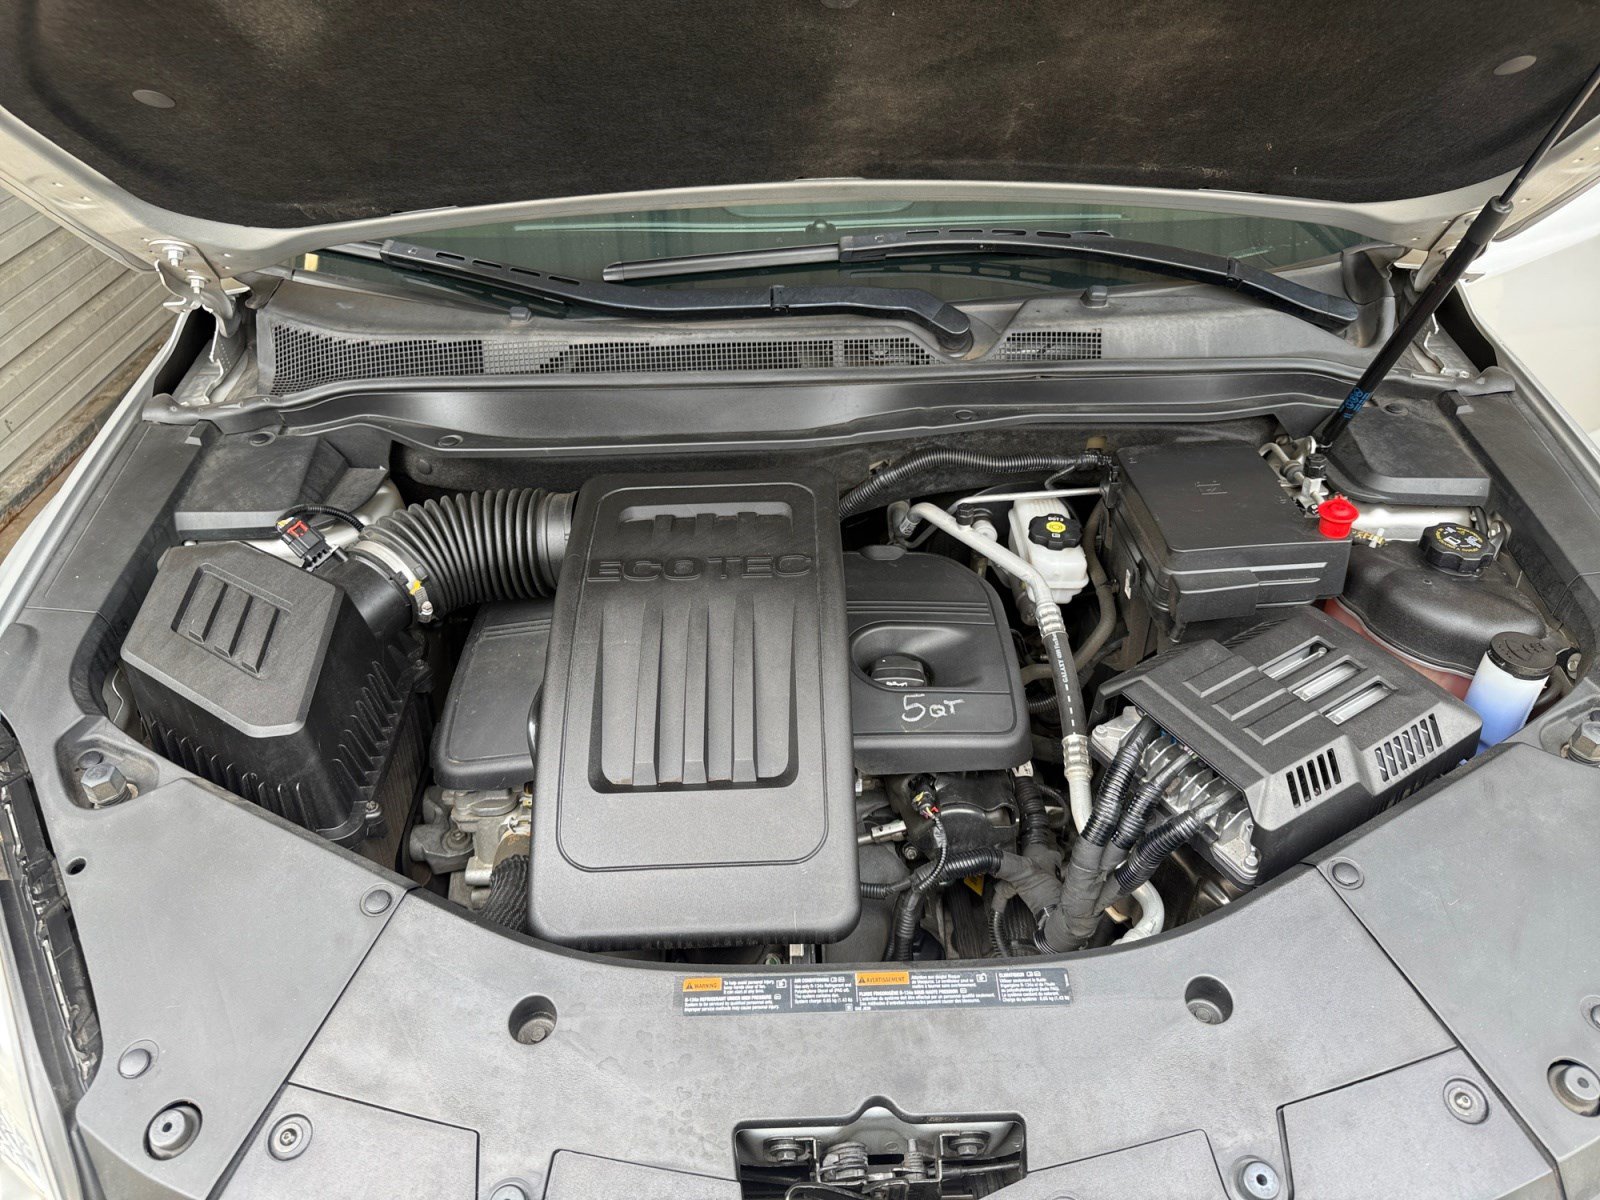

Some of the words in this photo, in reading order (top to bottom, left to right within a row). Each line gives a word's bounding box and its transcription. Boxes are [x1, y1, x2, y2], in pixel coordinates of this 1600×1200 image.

[587, 555, 812, 582] ECOTEC
[901, 694, 926, 722] 5
[929, 699, 965, 718] QT
